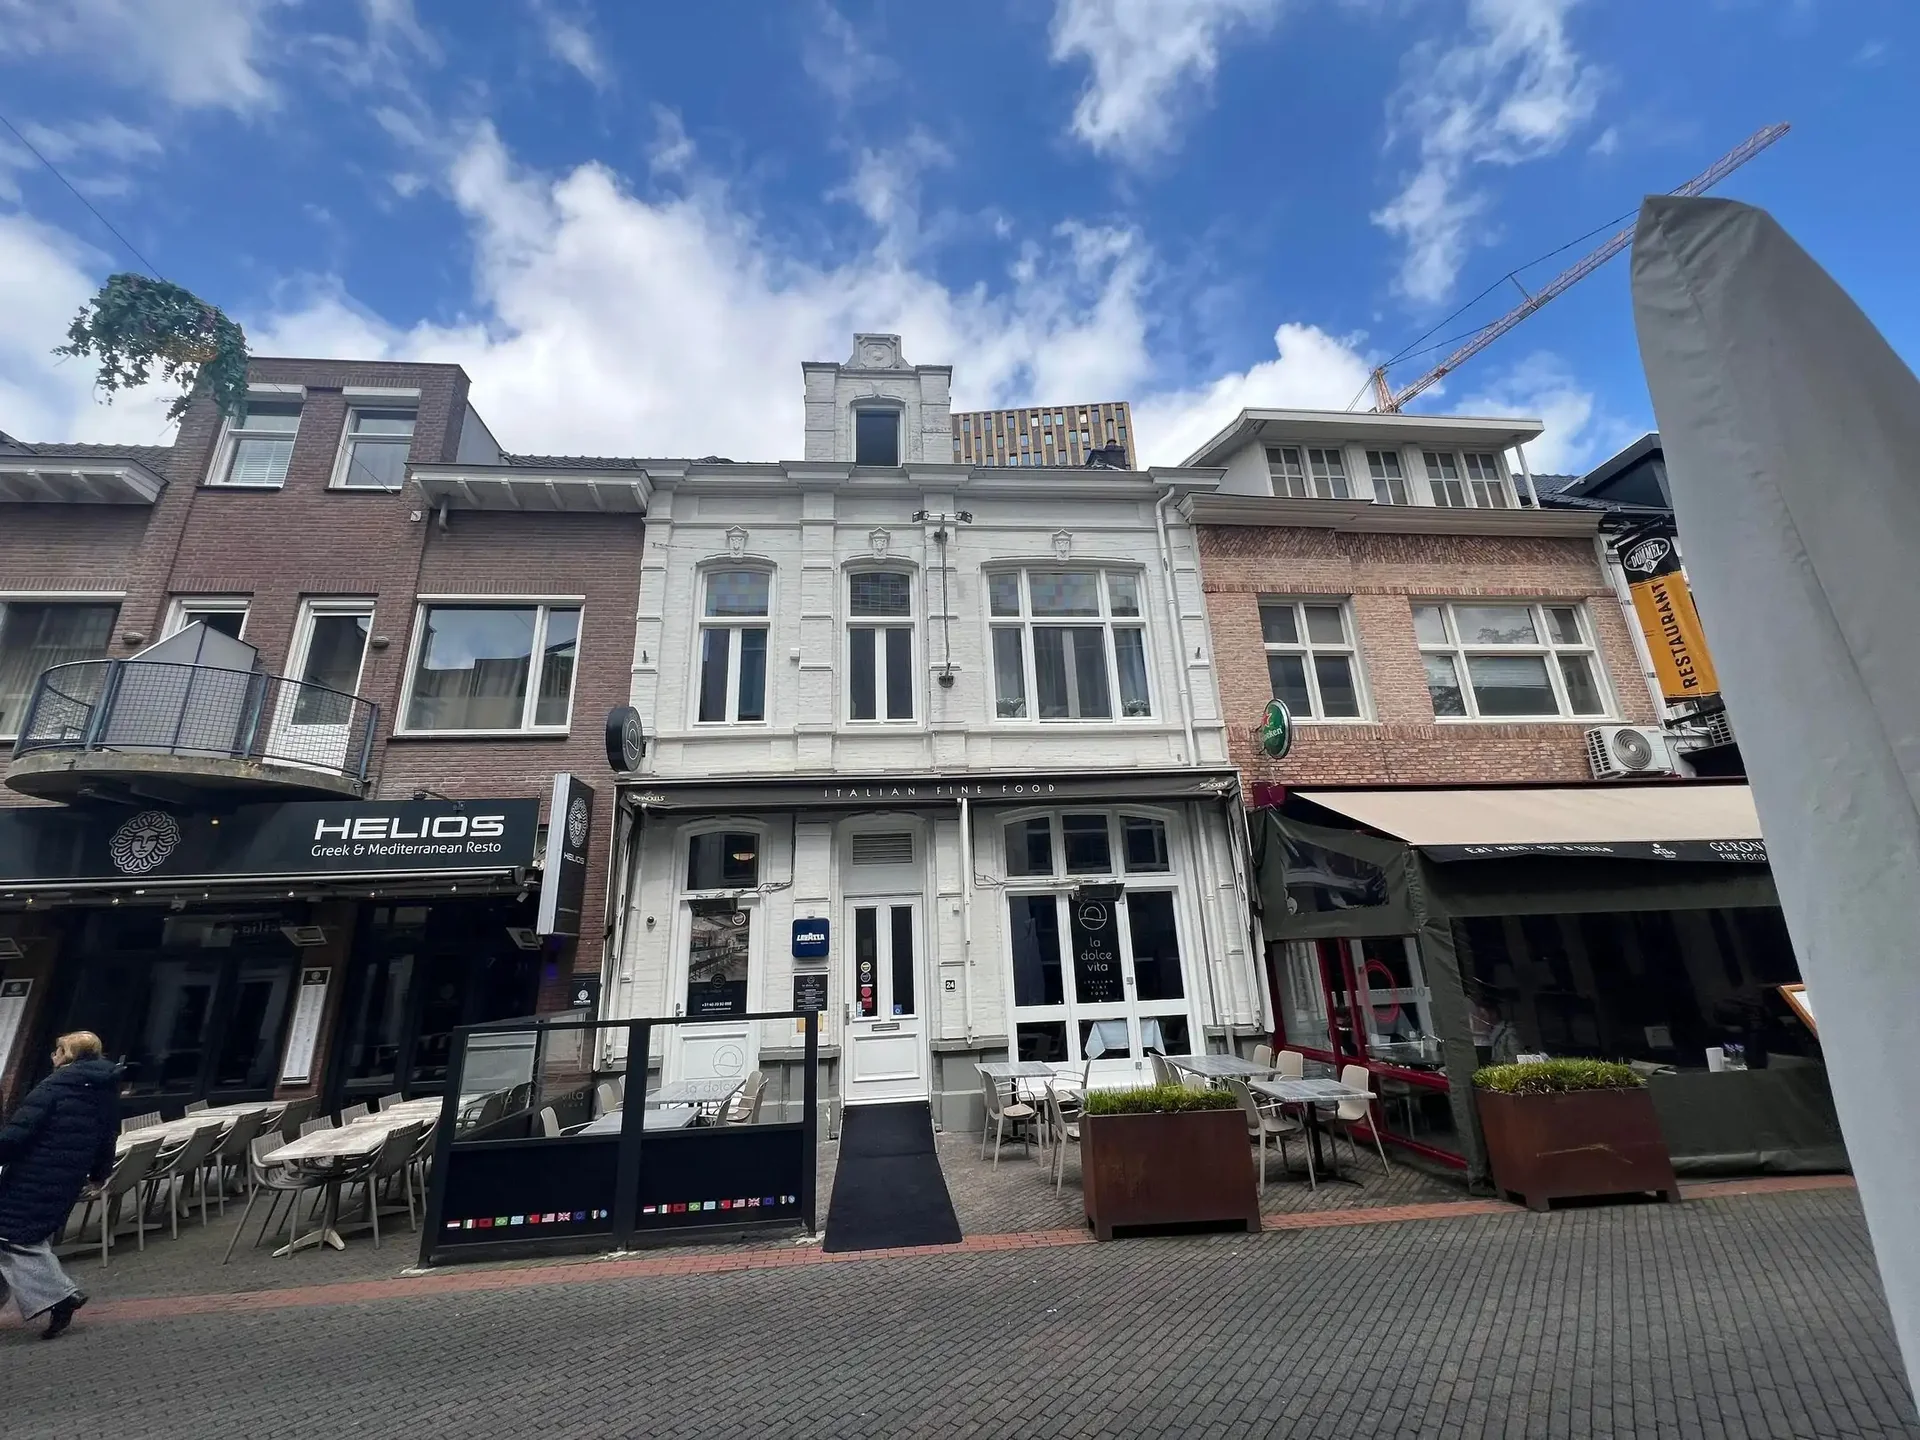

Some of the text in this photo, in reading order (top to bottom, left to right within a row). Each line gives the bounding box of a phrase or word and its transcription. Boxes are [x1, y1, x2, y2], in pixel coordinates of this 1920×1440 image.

[1651, 583, 1698, 689] RESTAURANT
[824, 784, 1055, 798] ITALIAN FINE FOOD
[314, 815, 505, 840] HELIOS
[311, 841, 502, 857] Greek & Mediterranean Resto
[563, 852, 585, 865] HELIOS
[1720, 853, 1766, 861] FINE FOOD
[1089, 936, 1101, 947] la
[1080, 950, 1112, 960] dolce
[1086, 962, 1109, 972] vita
[946, 981, 955, 989] 24
